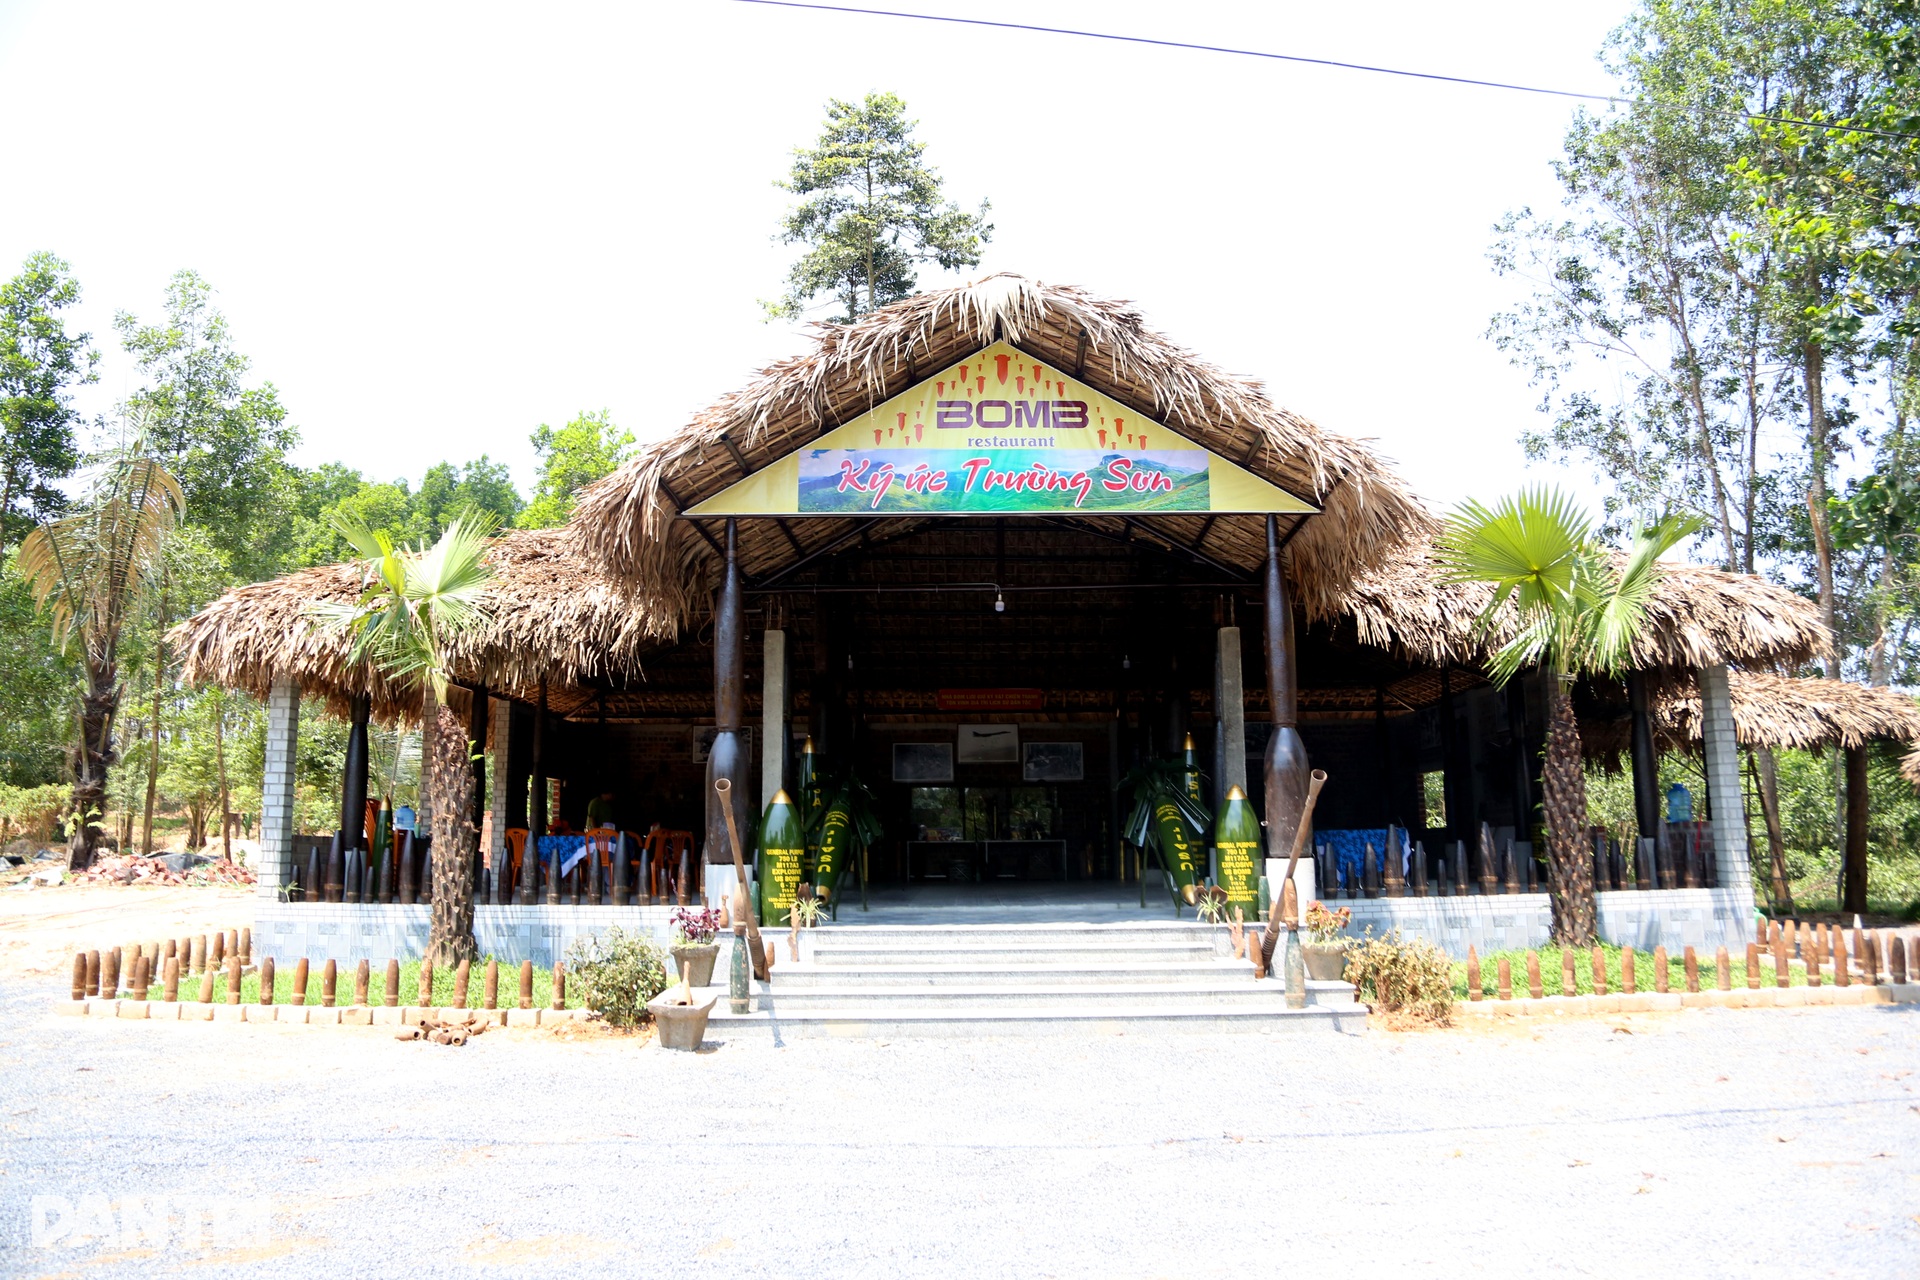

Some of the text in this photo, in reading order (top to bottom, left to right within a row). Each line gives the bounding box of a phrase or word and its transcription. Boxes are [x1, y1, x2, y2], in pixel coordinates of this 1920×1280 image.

[968, 436, 1055, 448] restaurant
[838, 457, 1172, 509] Ký ức Trường Sơn
